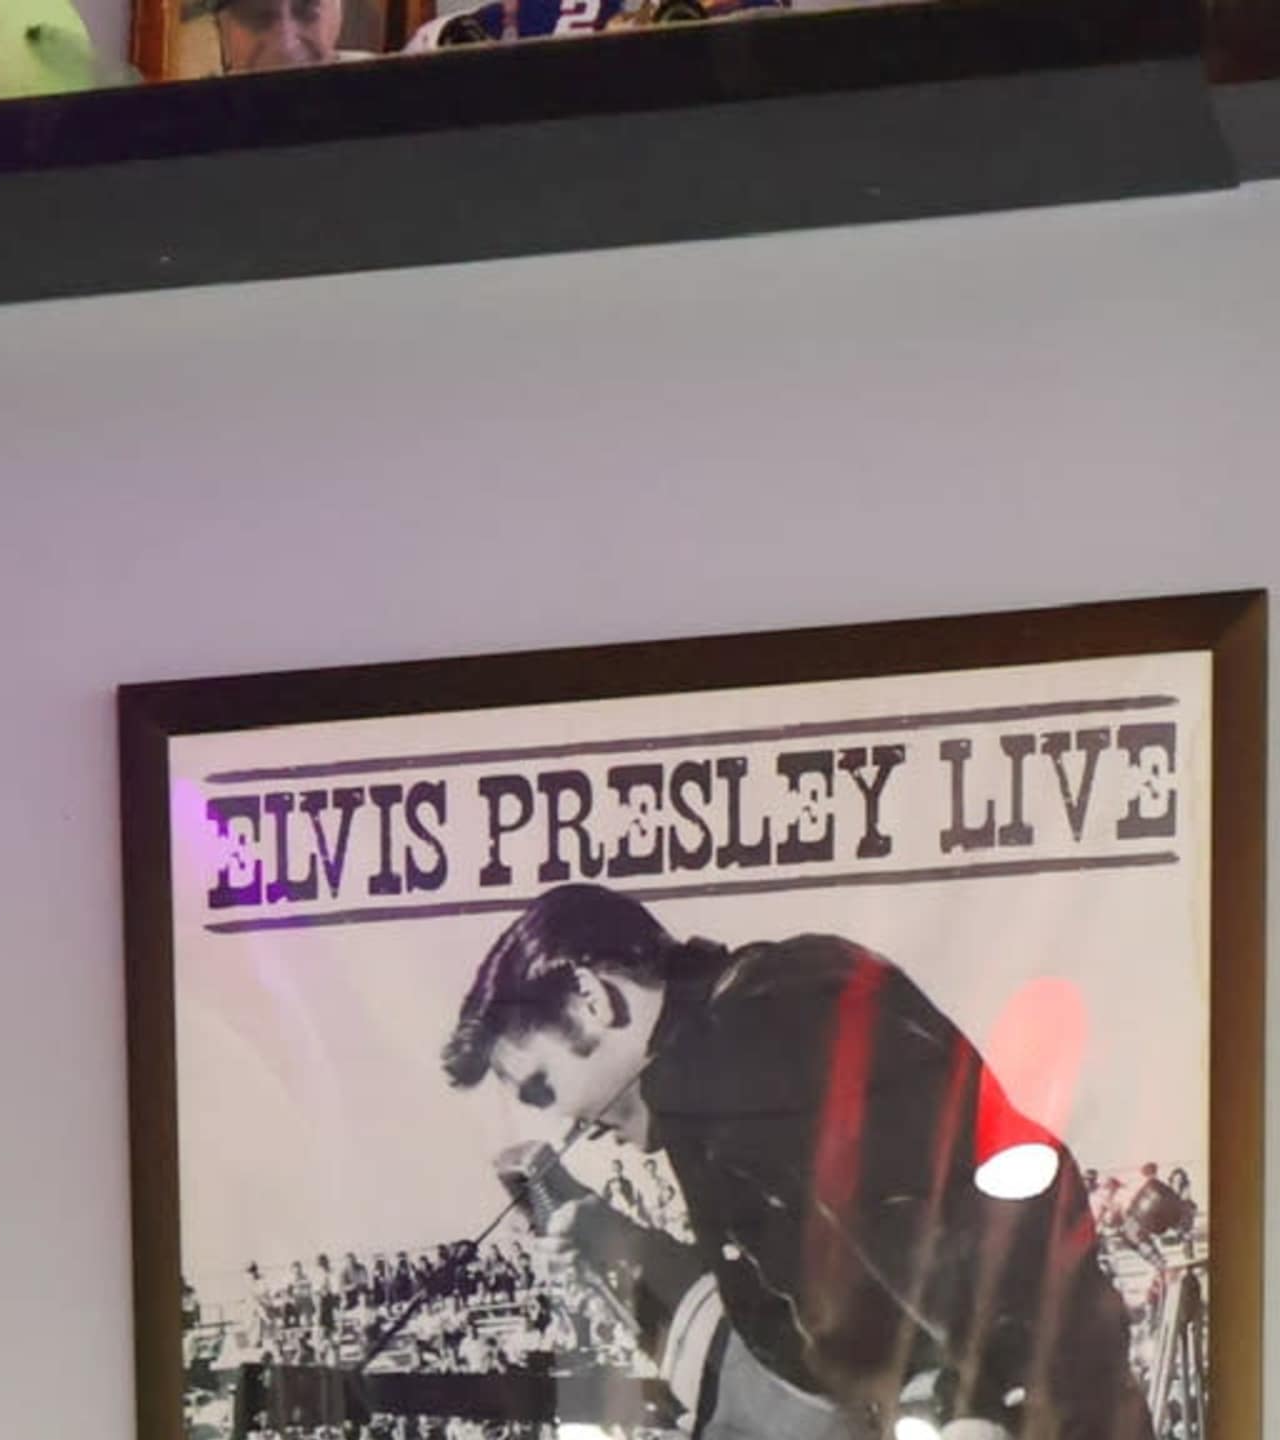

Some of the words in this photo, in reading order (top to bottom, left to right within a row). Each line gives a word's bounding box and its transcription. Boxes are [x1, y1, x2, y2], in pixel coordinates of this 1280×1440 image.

[206, 778, 449, 909] ELVIS
[477, 743, 907, 889] PRESLEY
[937, 721, 1179, 853] LIVE
